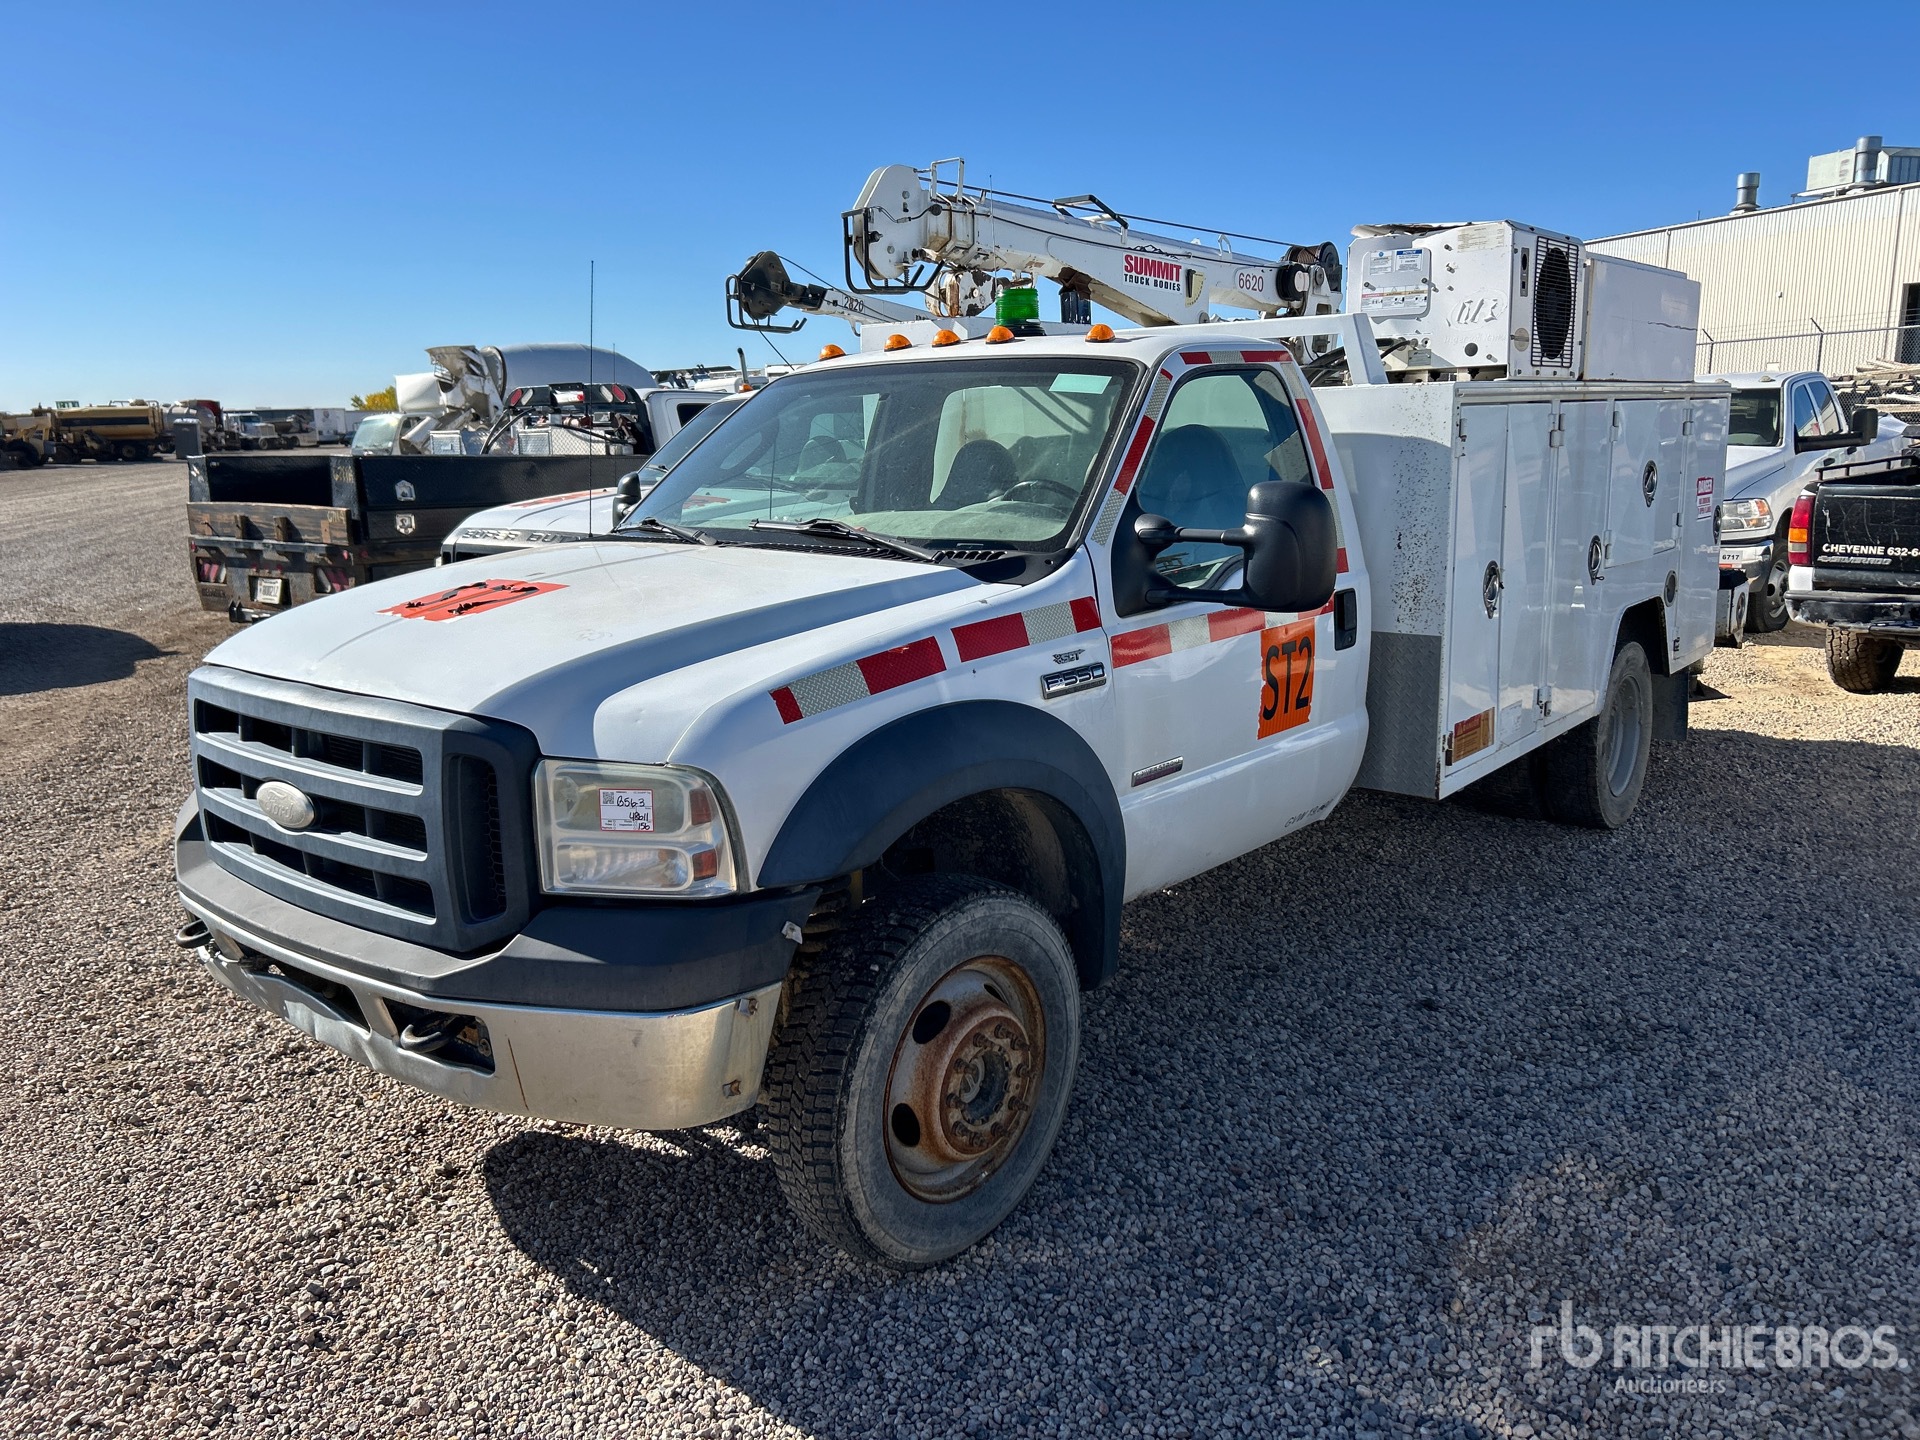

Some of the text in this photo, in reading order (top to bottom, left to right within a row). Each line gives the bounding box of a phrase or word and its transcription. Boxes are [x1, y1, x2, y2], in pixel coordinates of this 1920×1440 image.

[1124, 254, 1182, 283] SUMMIT
[1123, 273, 1181, 292] TRUCK BODIES
[1238, 273, 1264, 292] 6620
[844, 296, 864, 313] 2820
[462, 529, 521, 541] SUPER
[1822, 543, 1920, 557] CHEYENNE 632-6
[1263, 636, 1312, 721] ST2
